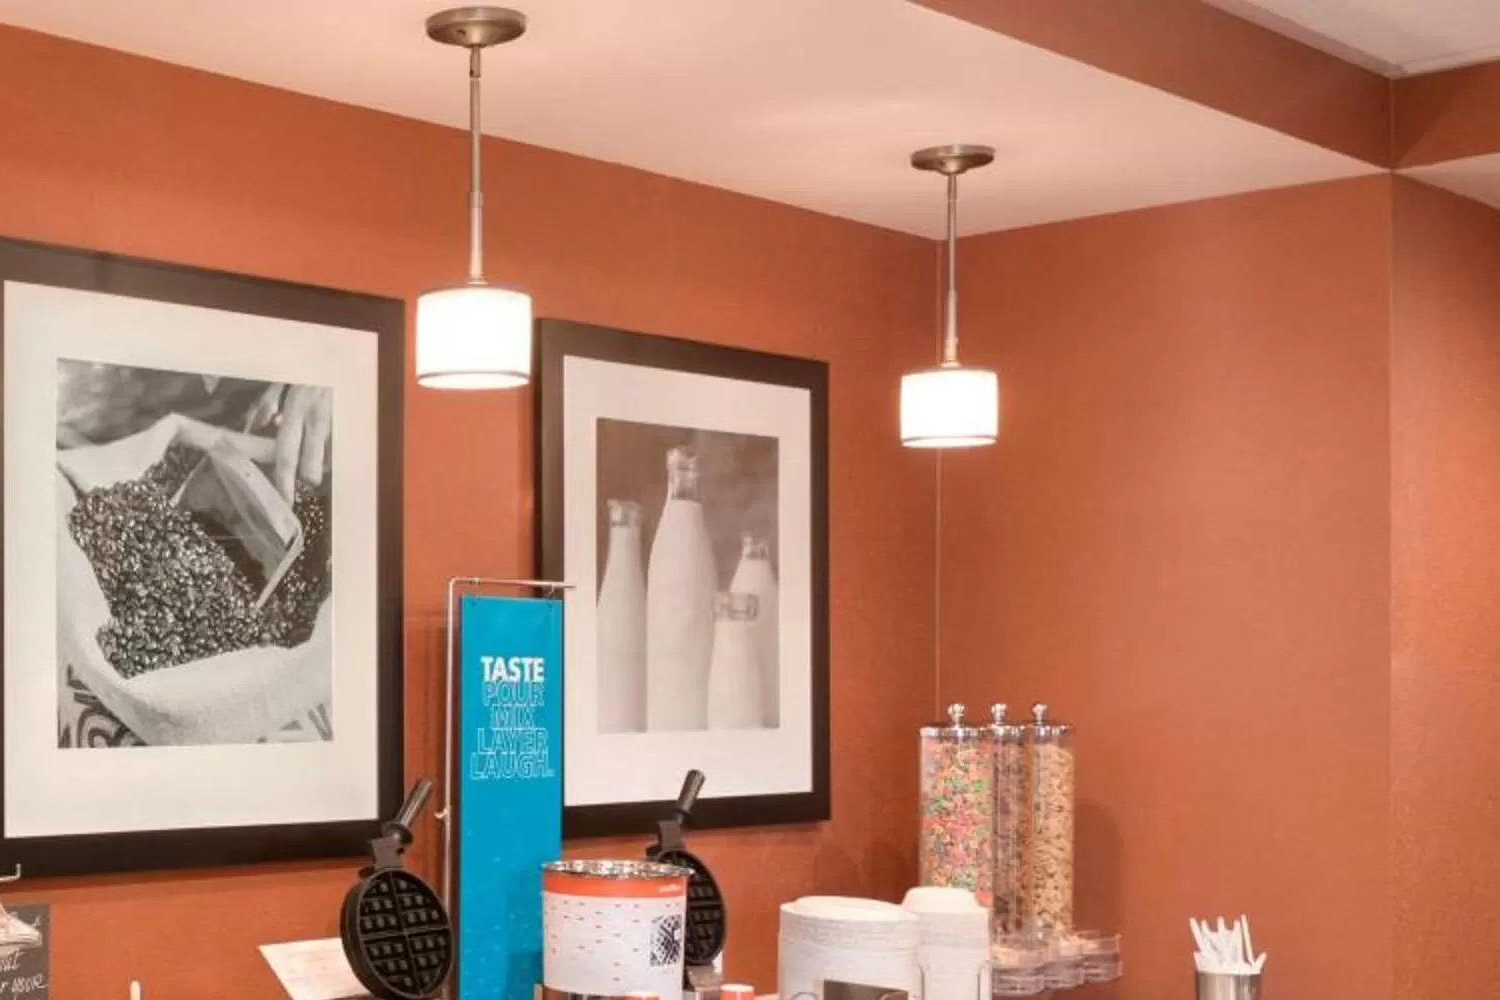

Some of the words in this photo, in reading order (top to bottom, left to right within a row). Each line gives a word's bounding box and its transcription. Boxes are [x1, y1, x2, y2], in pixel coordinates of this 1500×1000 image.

[480, 656, 545, 682] TASTE
[483, 681, 545, 707] POUR
[491, 703, 535, 729] MIX
[477, 727, 549, 754] LAYER
[469, 752, 555, 780] LAUGH.
